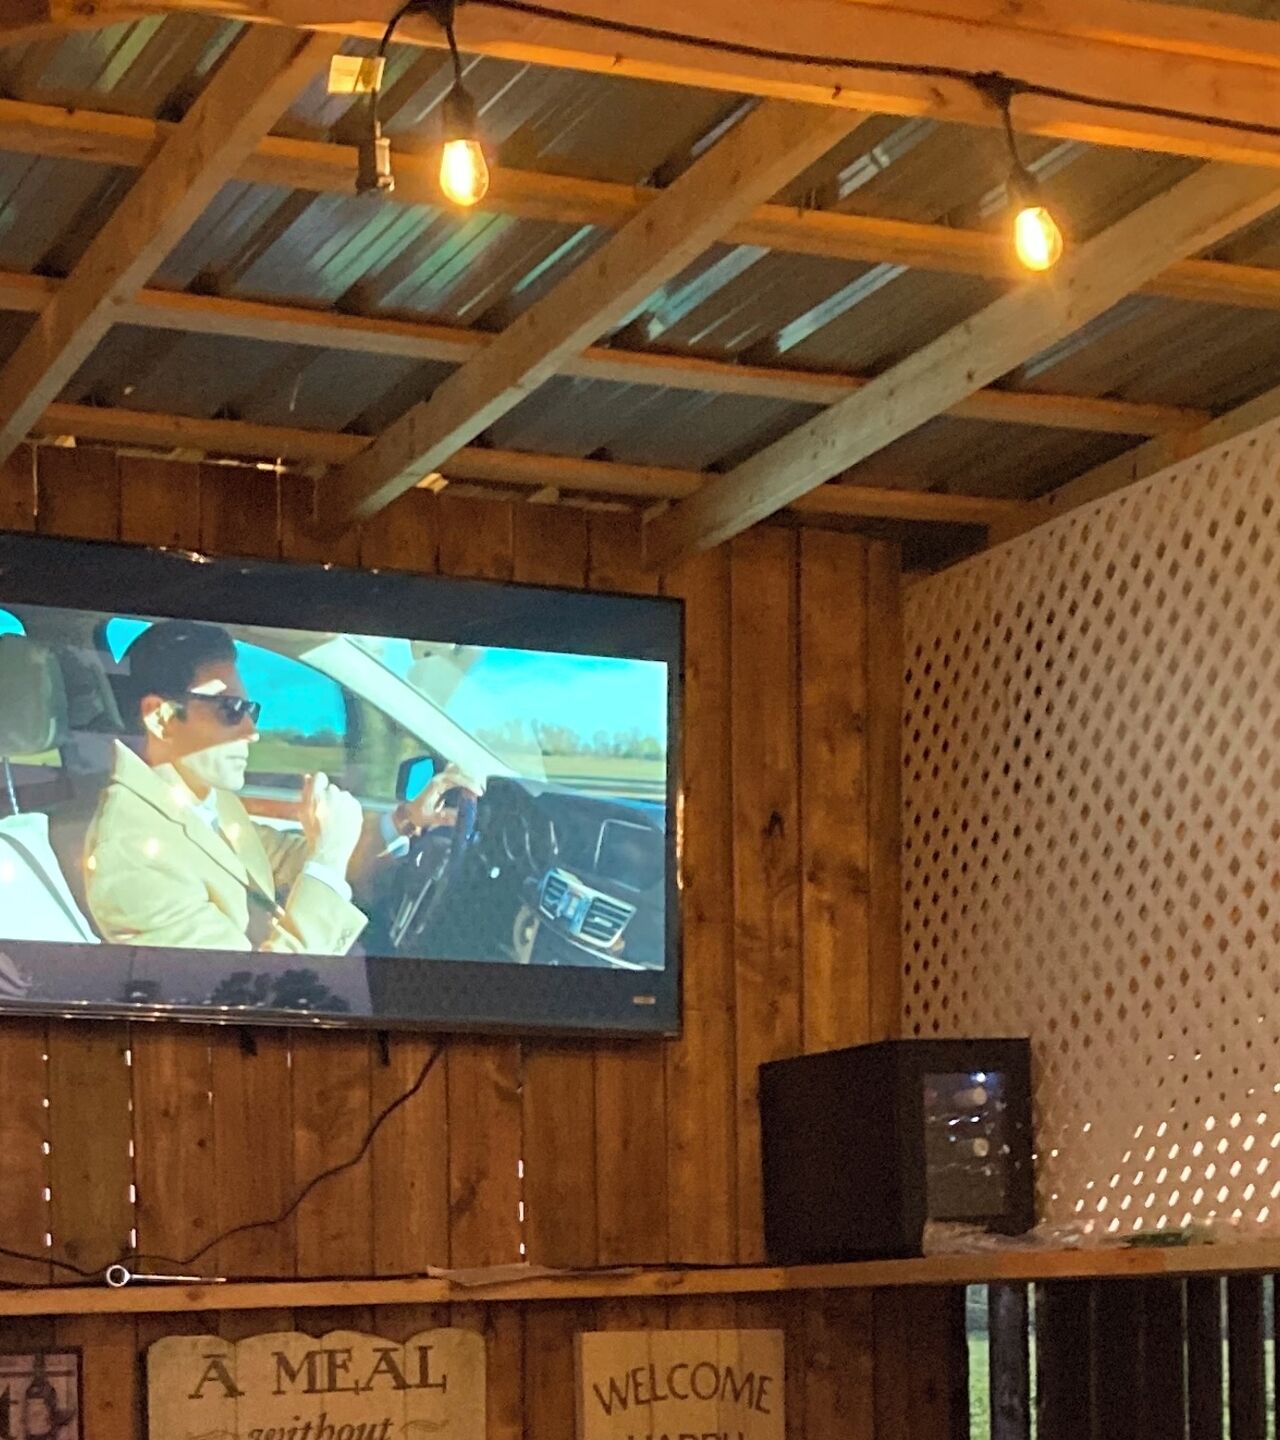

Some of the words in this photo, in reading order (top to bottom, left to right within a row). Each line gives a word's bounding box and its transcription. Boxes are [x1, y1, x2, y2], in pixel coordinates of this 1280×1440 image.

[188, 1354, 244, 1399] A
[271, 1344, 447, 1395] MEAL
[592, 1361, 774, 1416] WELCOME
